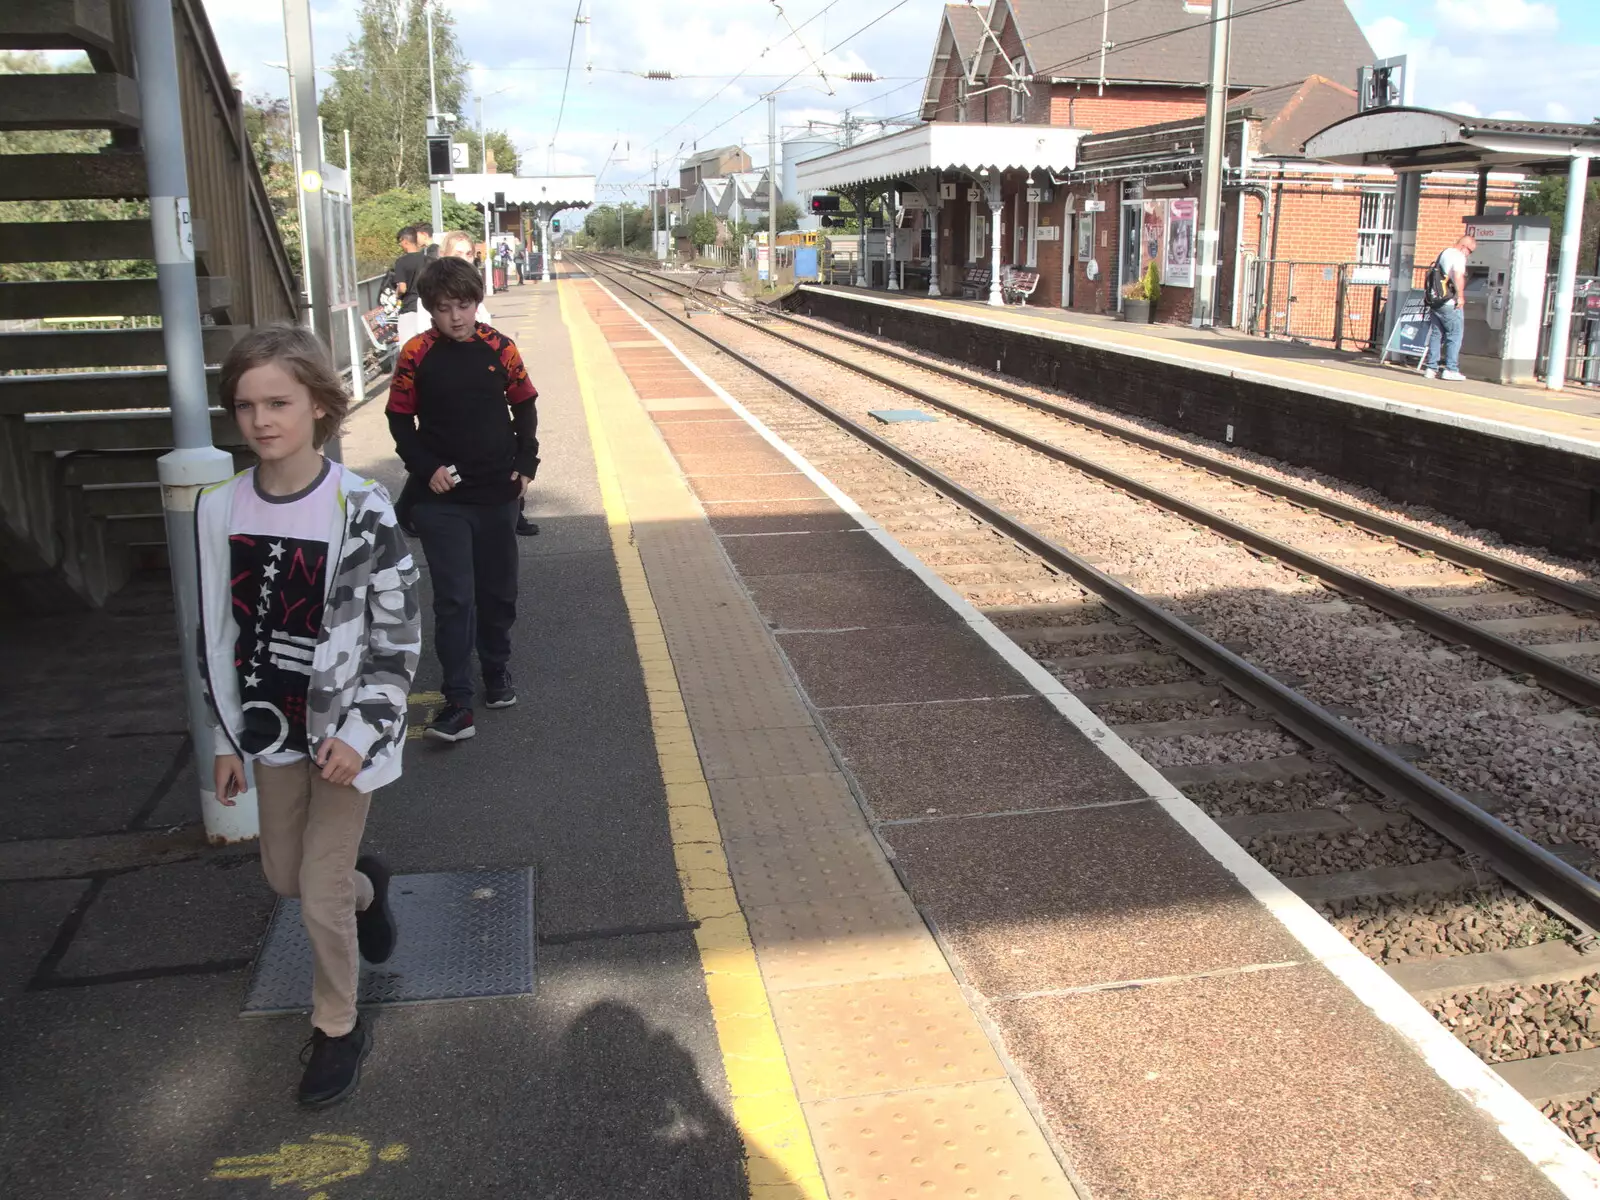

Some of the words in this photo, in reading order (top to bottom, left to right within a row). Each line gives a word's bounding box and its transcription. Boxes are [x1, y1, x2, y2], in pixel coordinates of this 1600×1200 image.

[452, 147, 462, 163] 2
[945, 186, 951, 197] 1
[1476, 228, 1494, 237] Tickets
